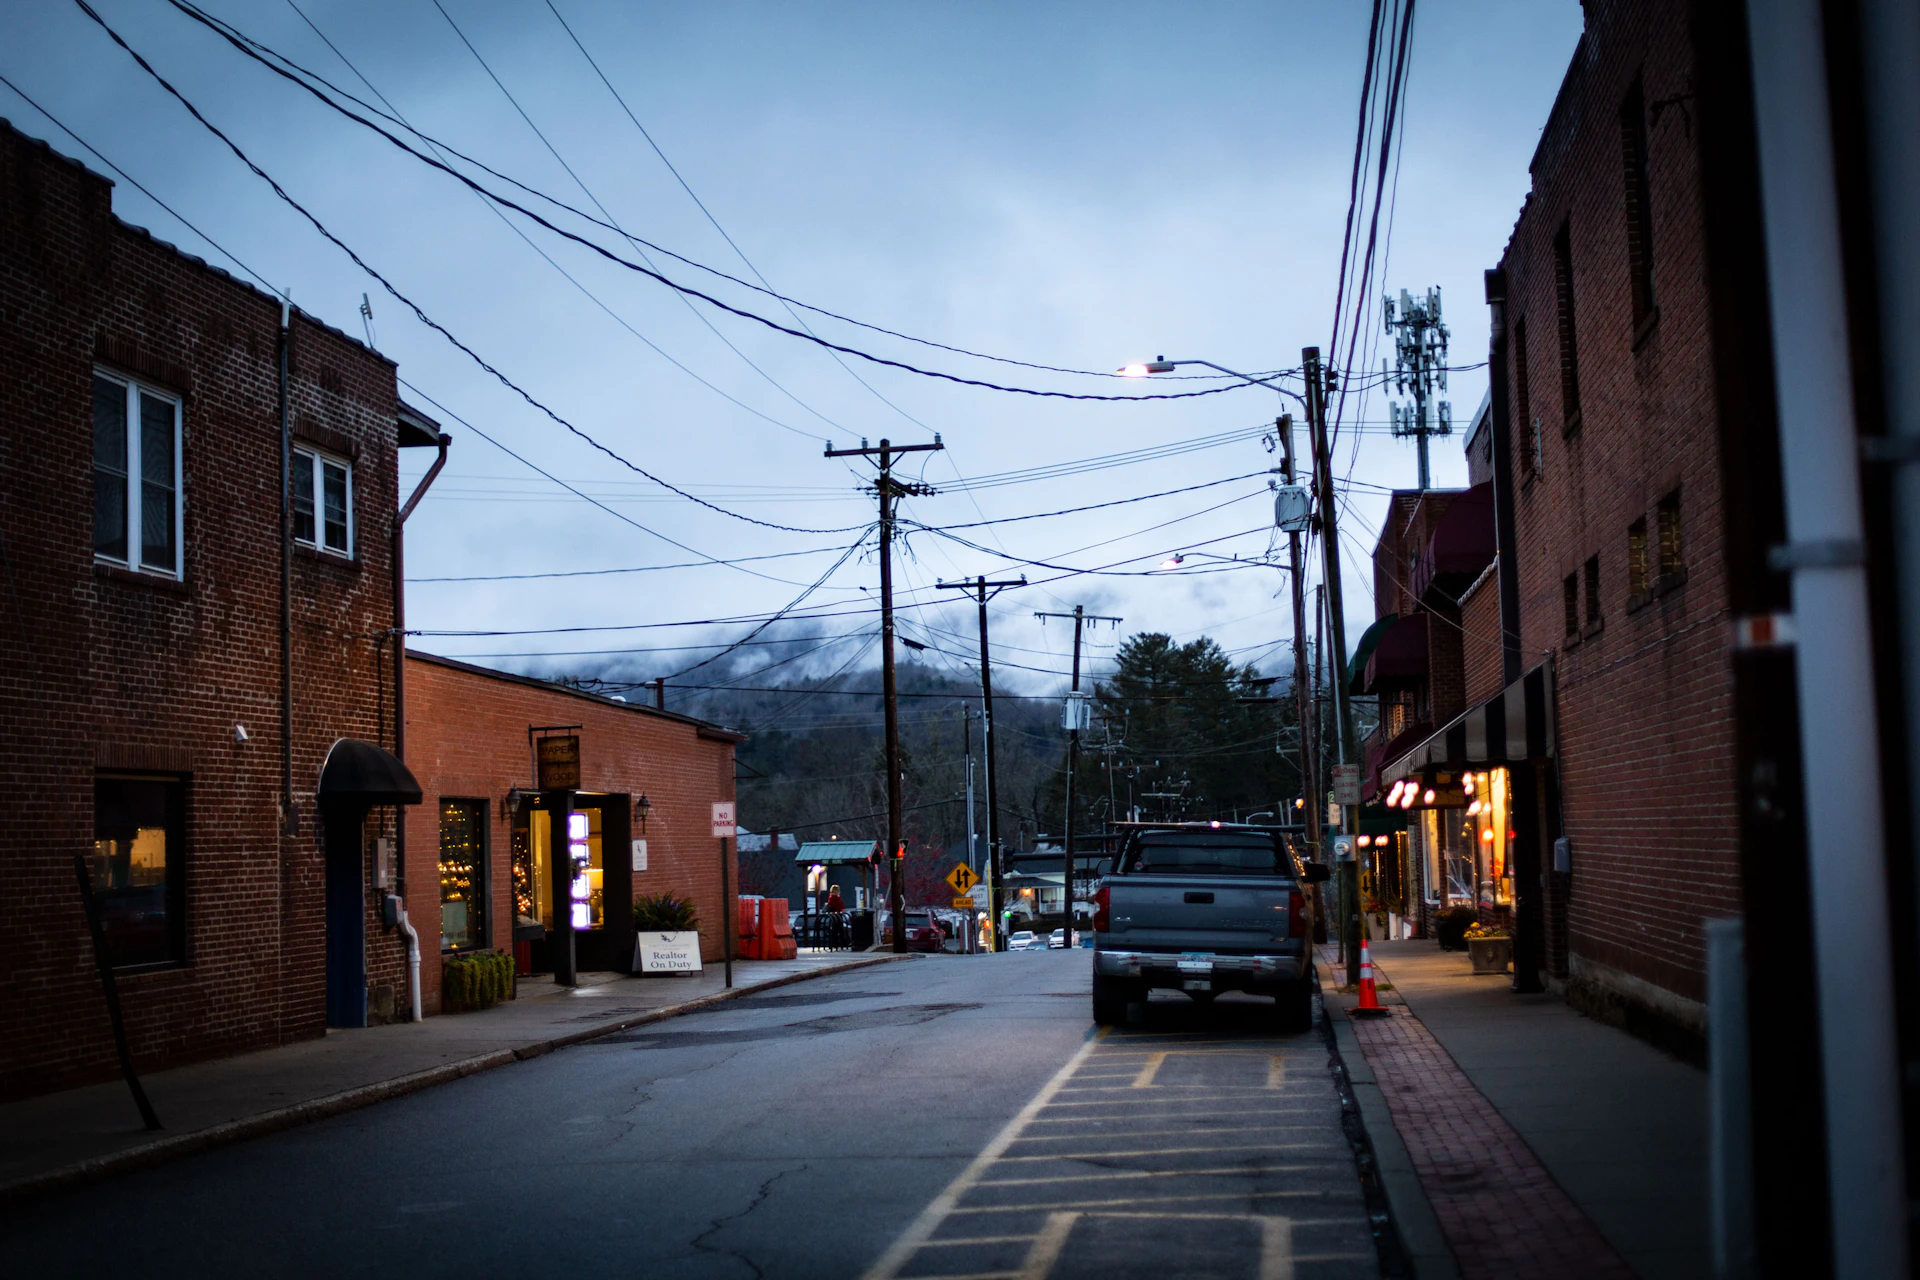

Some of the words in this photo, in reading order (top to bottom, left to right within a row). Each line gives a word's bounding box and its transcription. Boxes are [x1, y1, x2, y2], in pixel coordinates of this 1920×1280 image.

[541, 745, 574, 755] PAPER
[543, 772, 574, 781] WOOD
[1219, 917, 1285, 928] TUNDRA
[653, 951, 688, 960] Realtor
[650, 960, 666, 969] On
[668, 960, 692, 970] Duty
